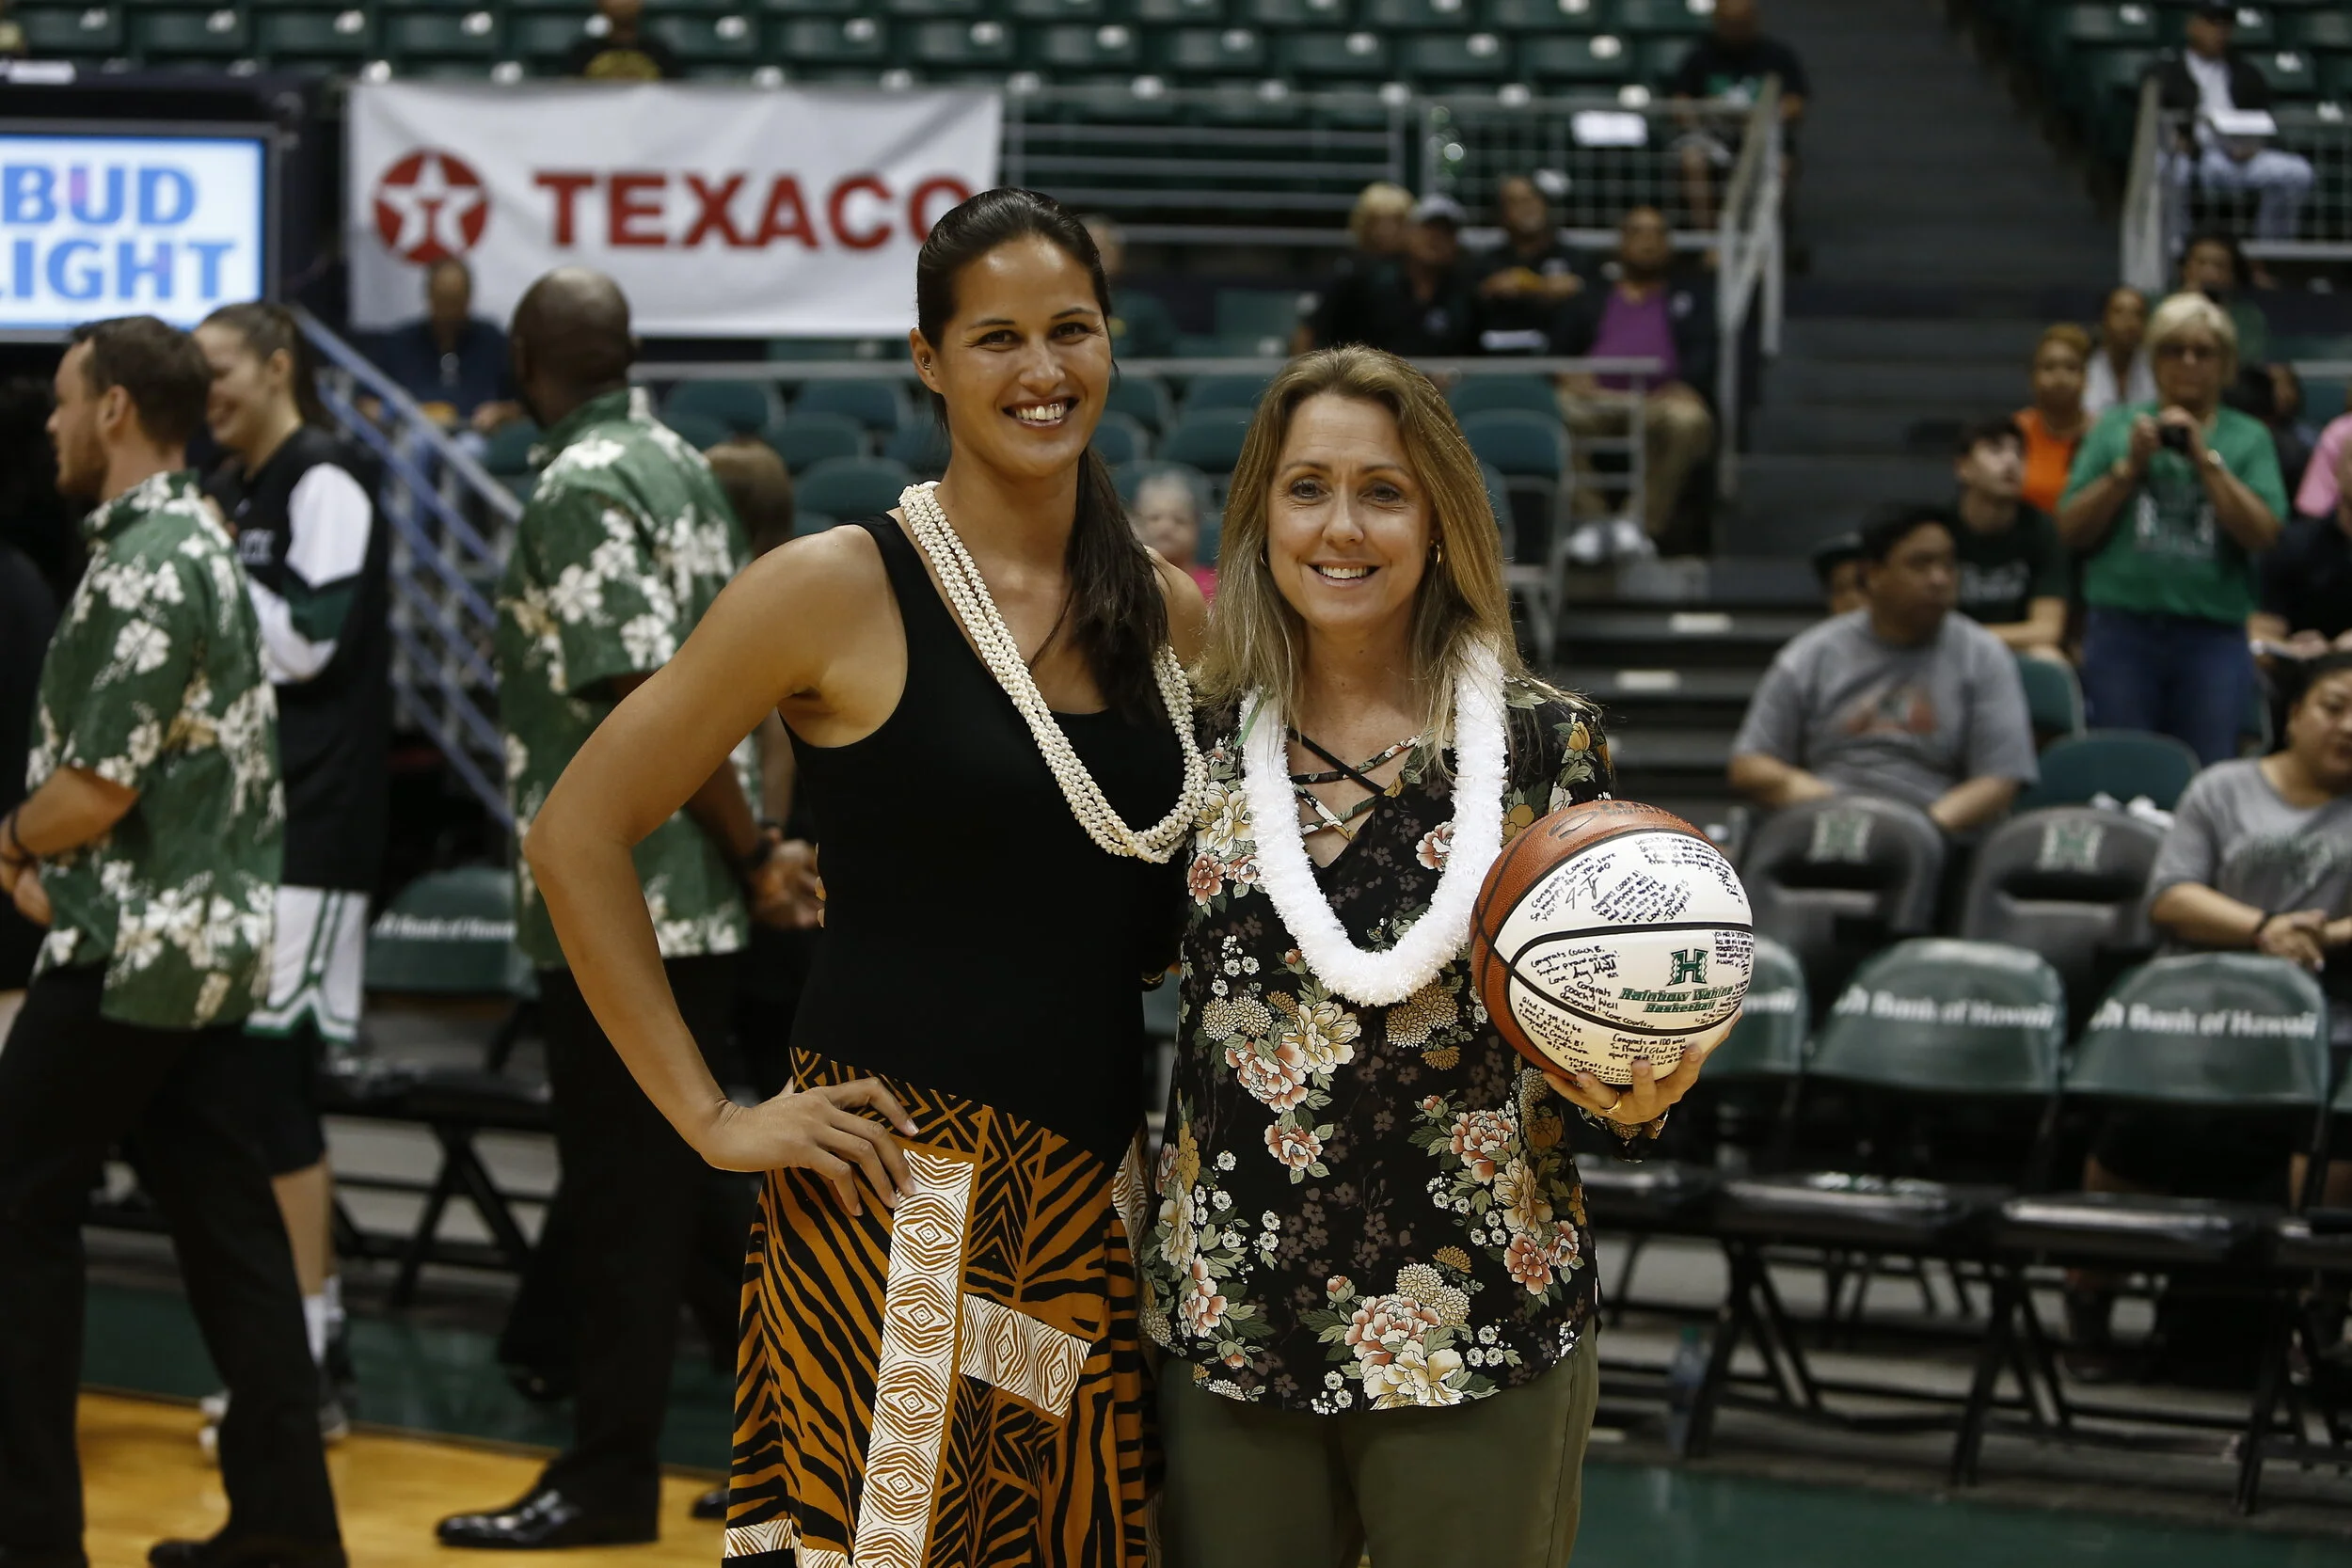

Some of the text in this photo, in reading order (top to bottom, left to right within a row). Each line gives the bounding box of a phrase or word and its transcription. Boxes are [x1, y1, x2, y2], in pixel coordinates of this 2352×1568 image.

[2, 165, 198, 227] BUD
[0, 239, 236, 300] IGHT
[1531, 951, 1566, 968] Congrats
[1665, 948, 1708, 986] H
[1618, 988, 1692, 1002] Rainbow
[1692, 985, 1733, 1001] Wahine
[1643, 999, 1716, 1012] Basketball
[2128, 1002, 2318, 1039] Bank of Hawaii
